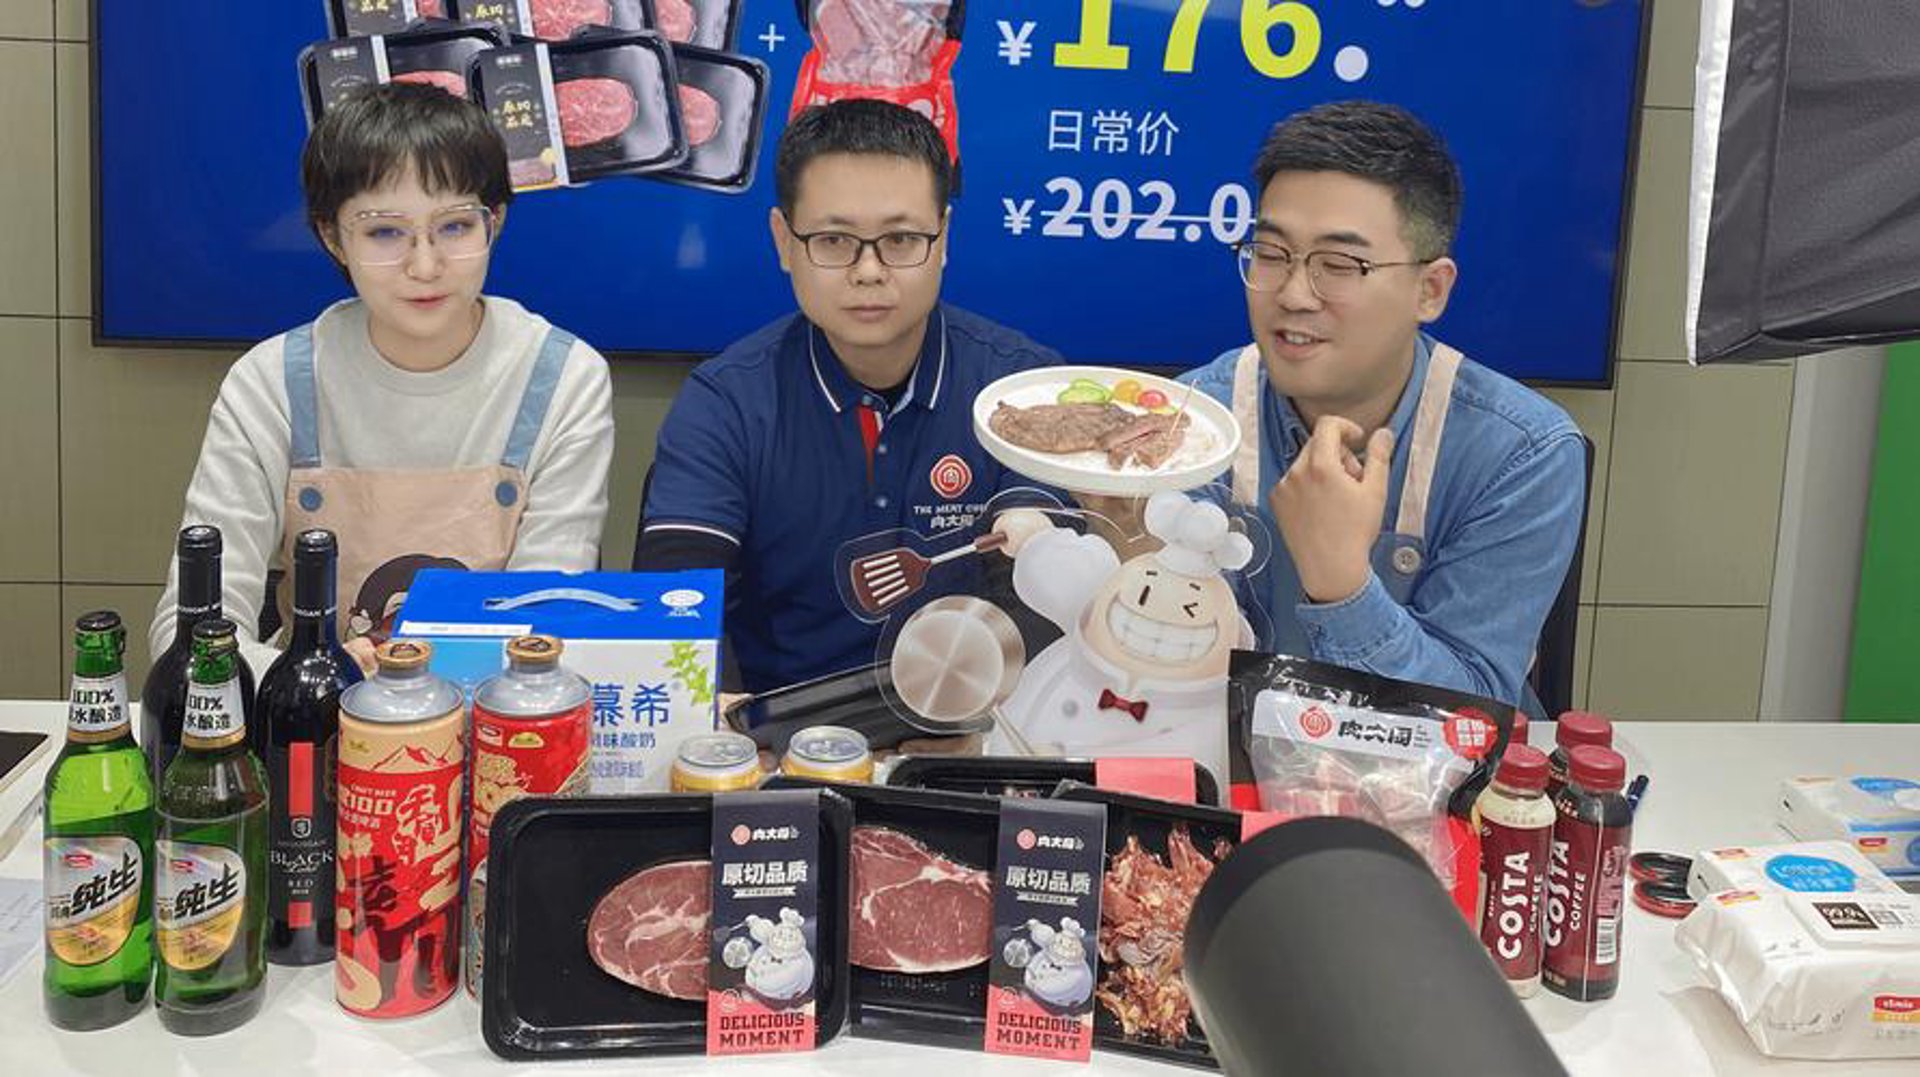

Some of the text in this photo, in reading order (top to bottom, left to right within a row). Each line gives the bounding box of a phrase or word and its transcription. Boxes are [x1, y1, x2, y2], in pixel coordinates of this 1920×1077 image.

[1047, 110, 1180, 157] 日常价
[270, 850, 333, 865] BLACK
[71, 852, 138, 917] 纯生
[721, 861, 809, 886] 原切品质
[1005, 866, 1092, 896] 原切品质
[174, 863, 238, 921] 纯生
[1497, 851, 1531, 959] COSTA
[1543, 840, 1570, 946] COSTA
[1570, 872, 1586, 931] COFFEE
[719, 1012, 805, 1031] DELICIOUS
[998, 1012, 1082, 1035] DELICIOUS
[719, 1029, 804, 1048] MOMENT
[996, 1028, 1081, 1051] MOMENT
